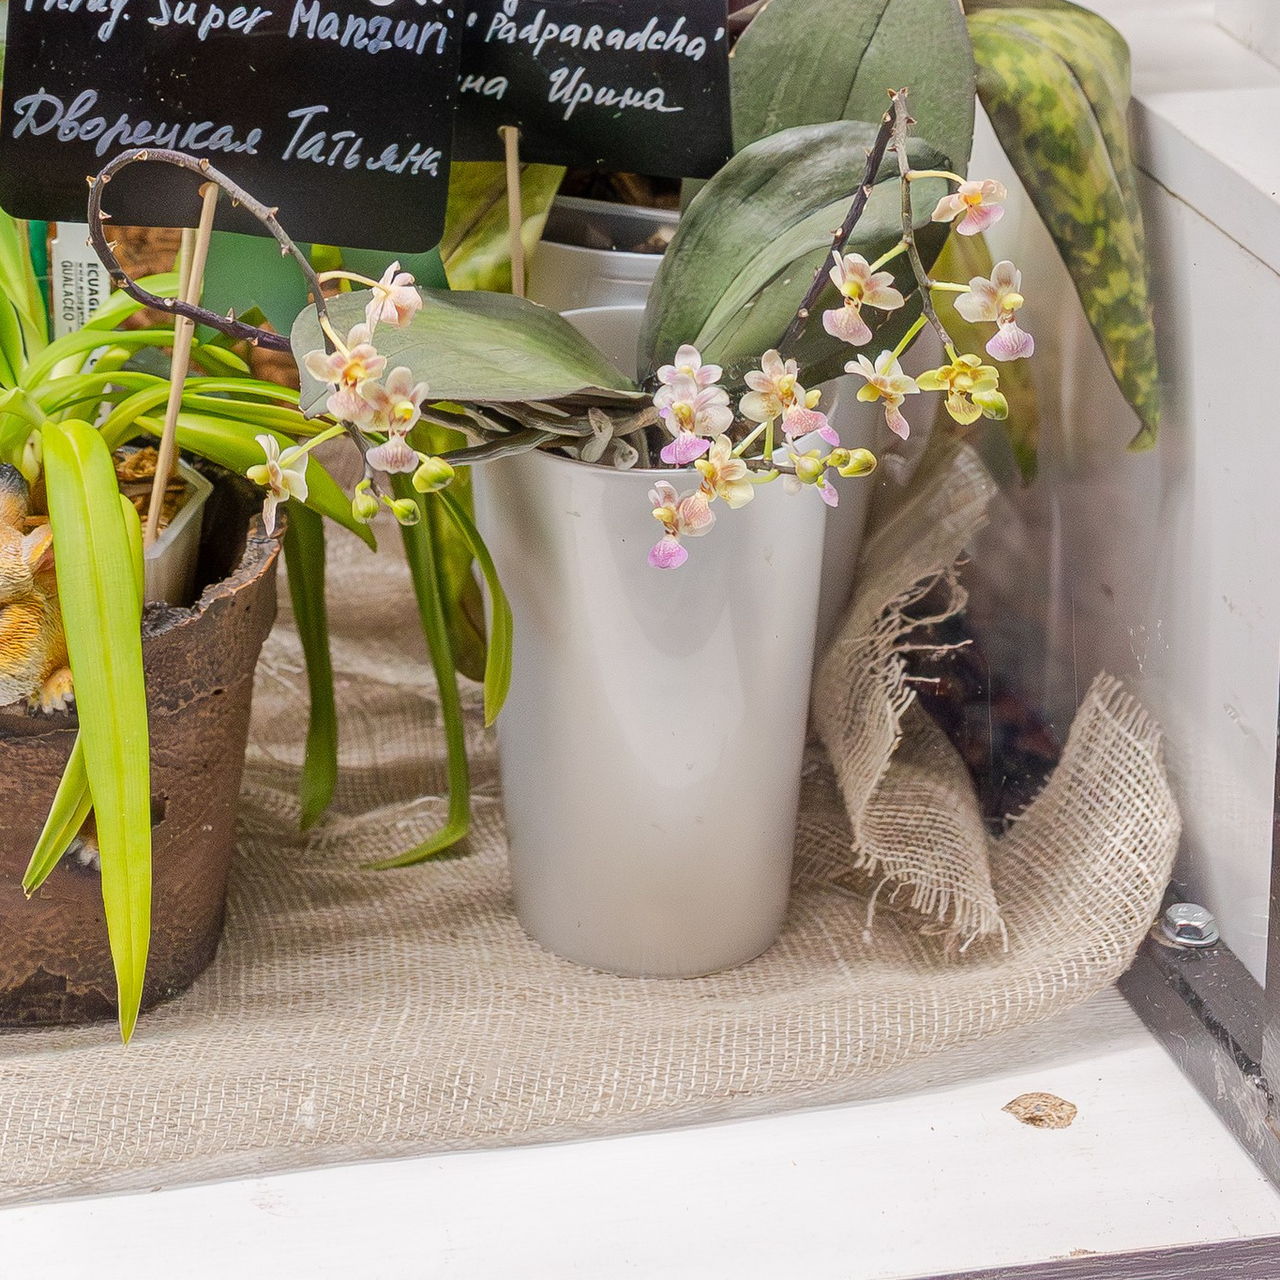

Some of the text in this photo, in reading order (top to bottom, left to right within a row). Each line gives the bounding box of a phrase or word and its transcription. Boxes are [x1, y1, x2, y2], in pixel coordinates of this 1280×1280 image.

[547, 65, 684, 121] Ирина
[12, 86, 444, 178] Дворецкая Татьяна
